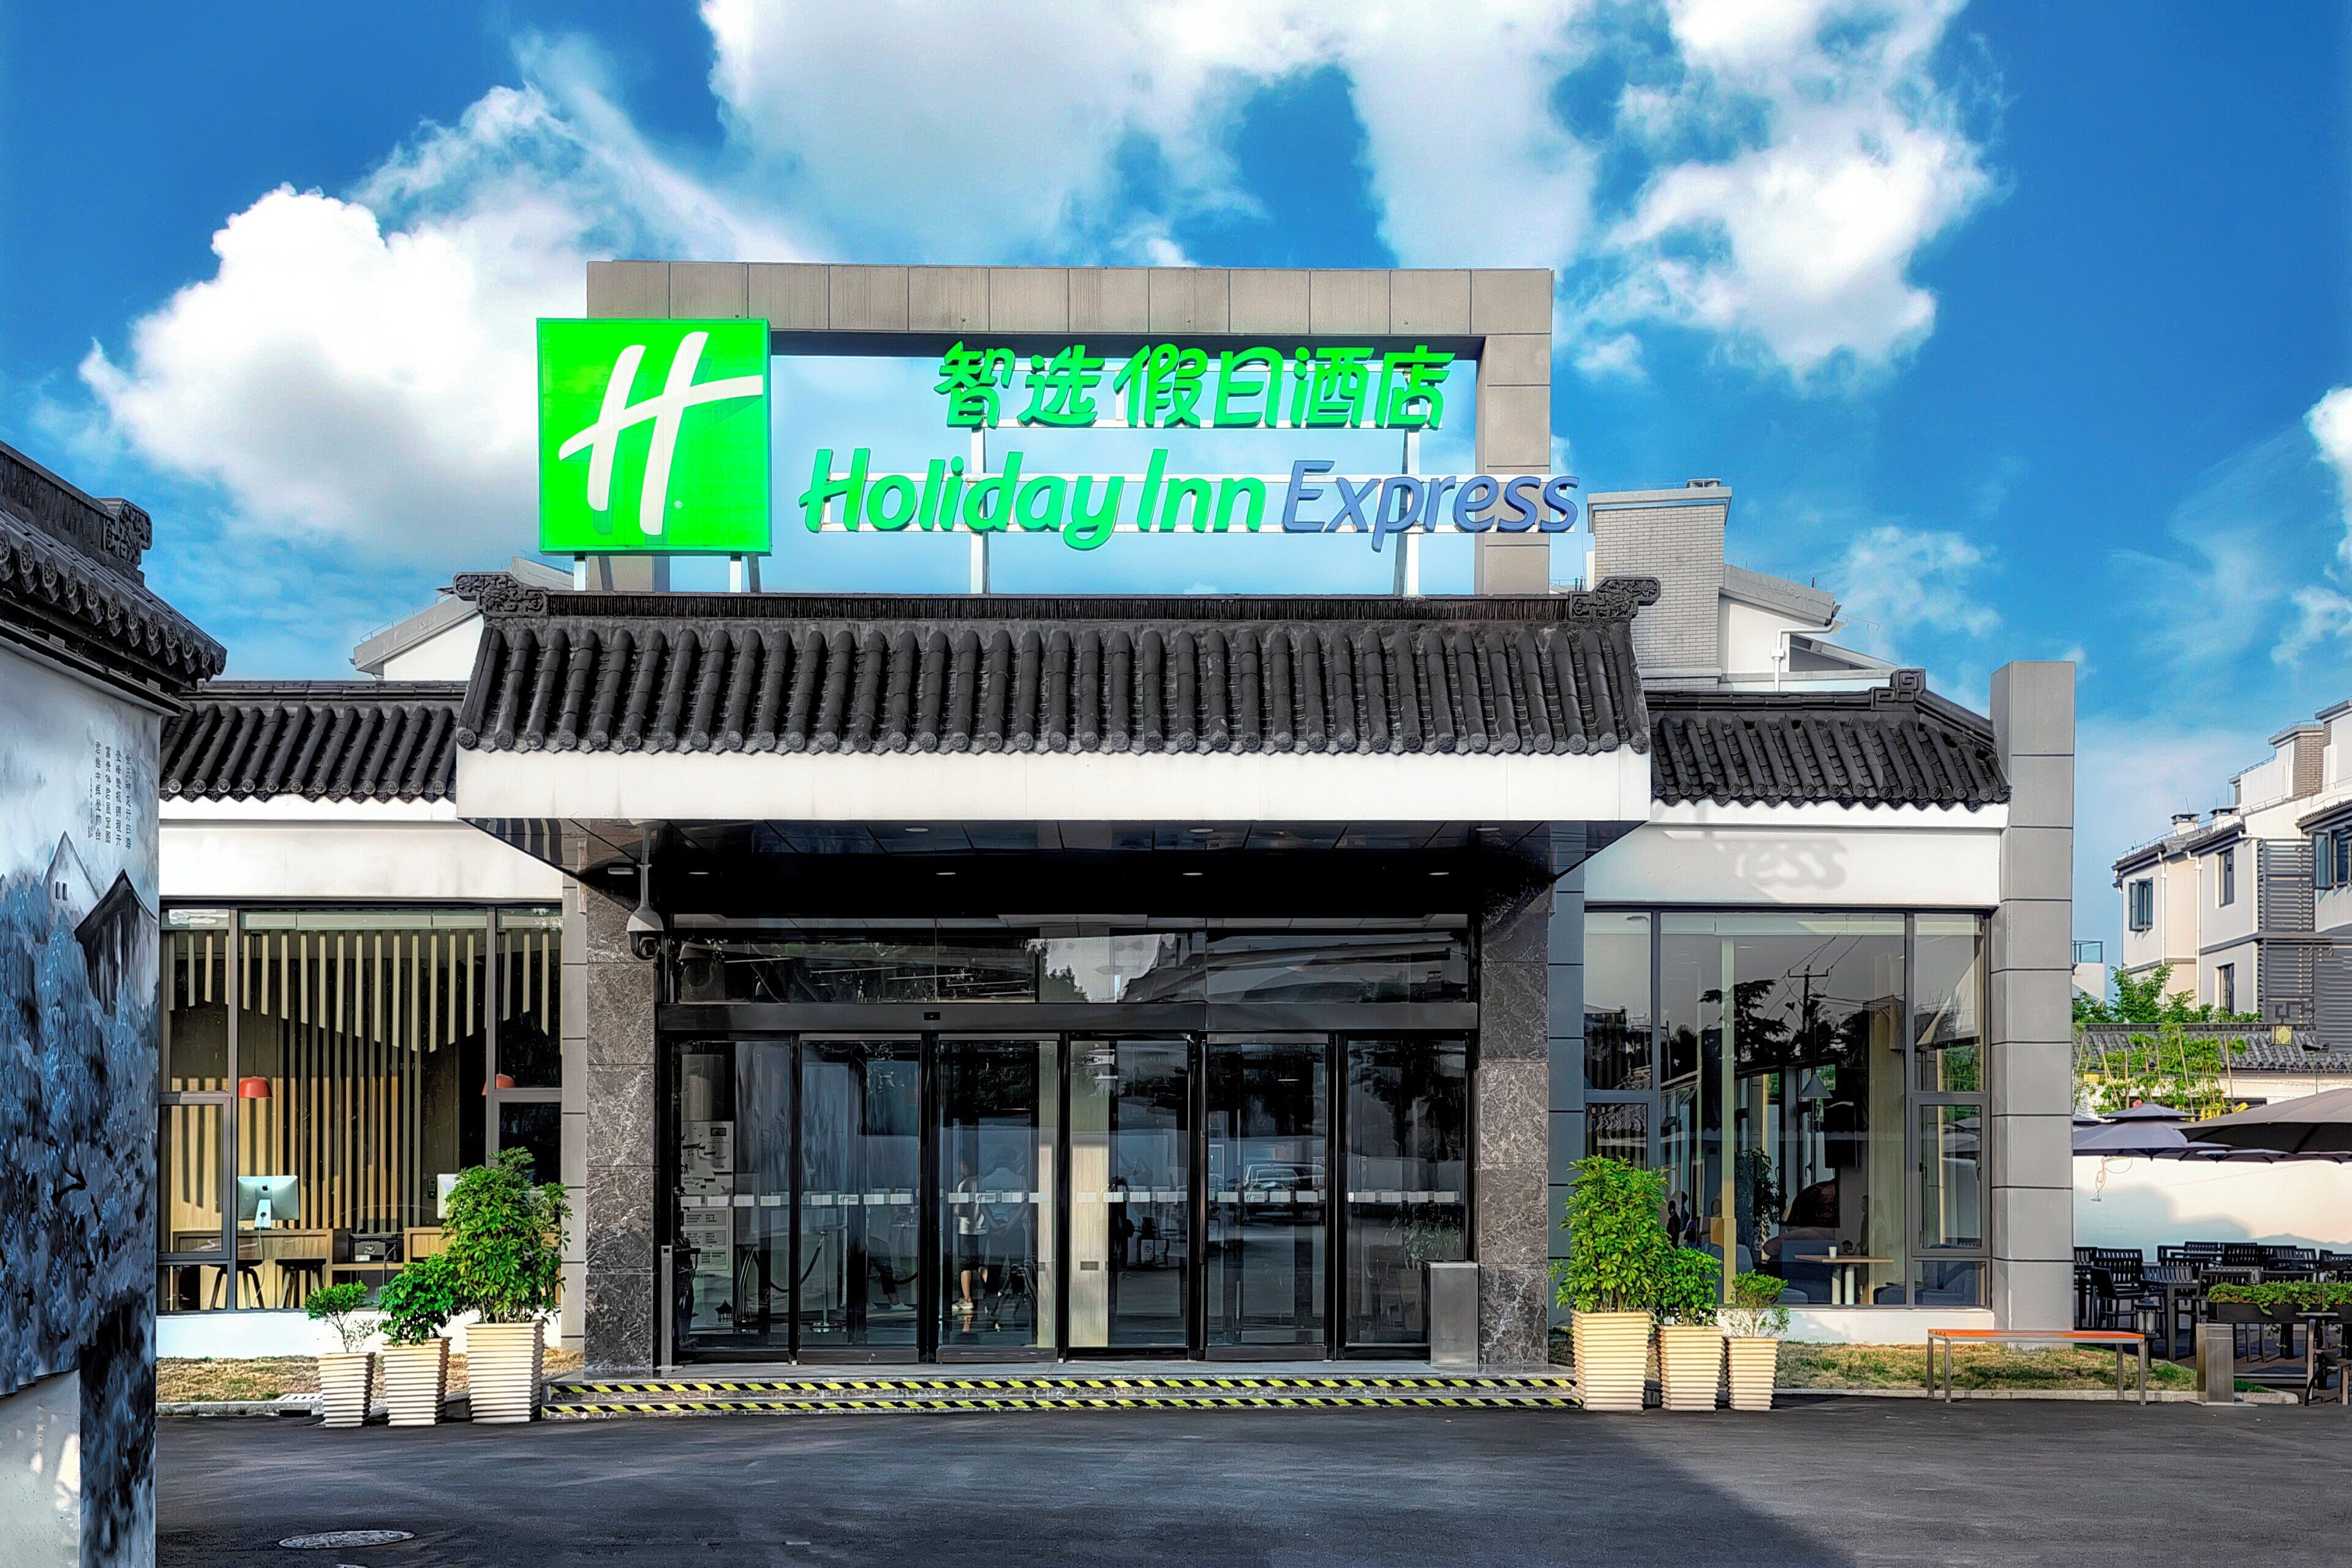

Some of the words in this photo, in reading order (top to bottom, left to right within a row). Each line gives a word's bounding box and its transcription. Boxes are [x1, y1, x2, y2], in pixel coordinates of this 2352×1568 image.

[934, 341, 1457, 430] 智选假日酒店
[799, 448, 1125, 551] Holiday
[1137, 449, 1266, 533] Inn
[1282, 460, 1580, 552] Express
